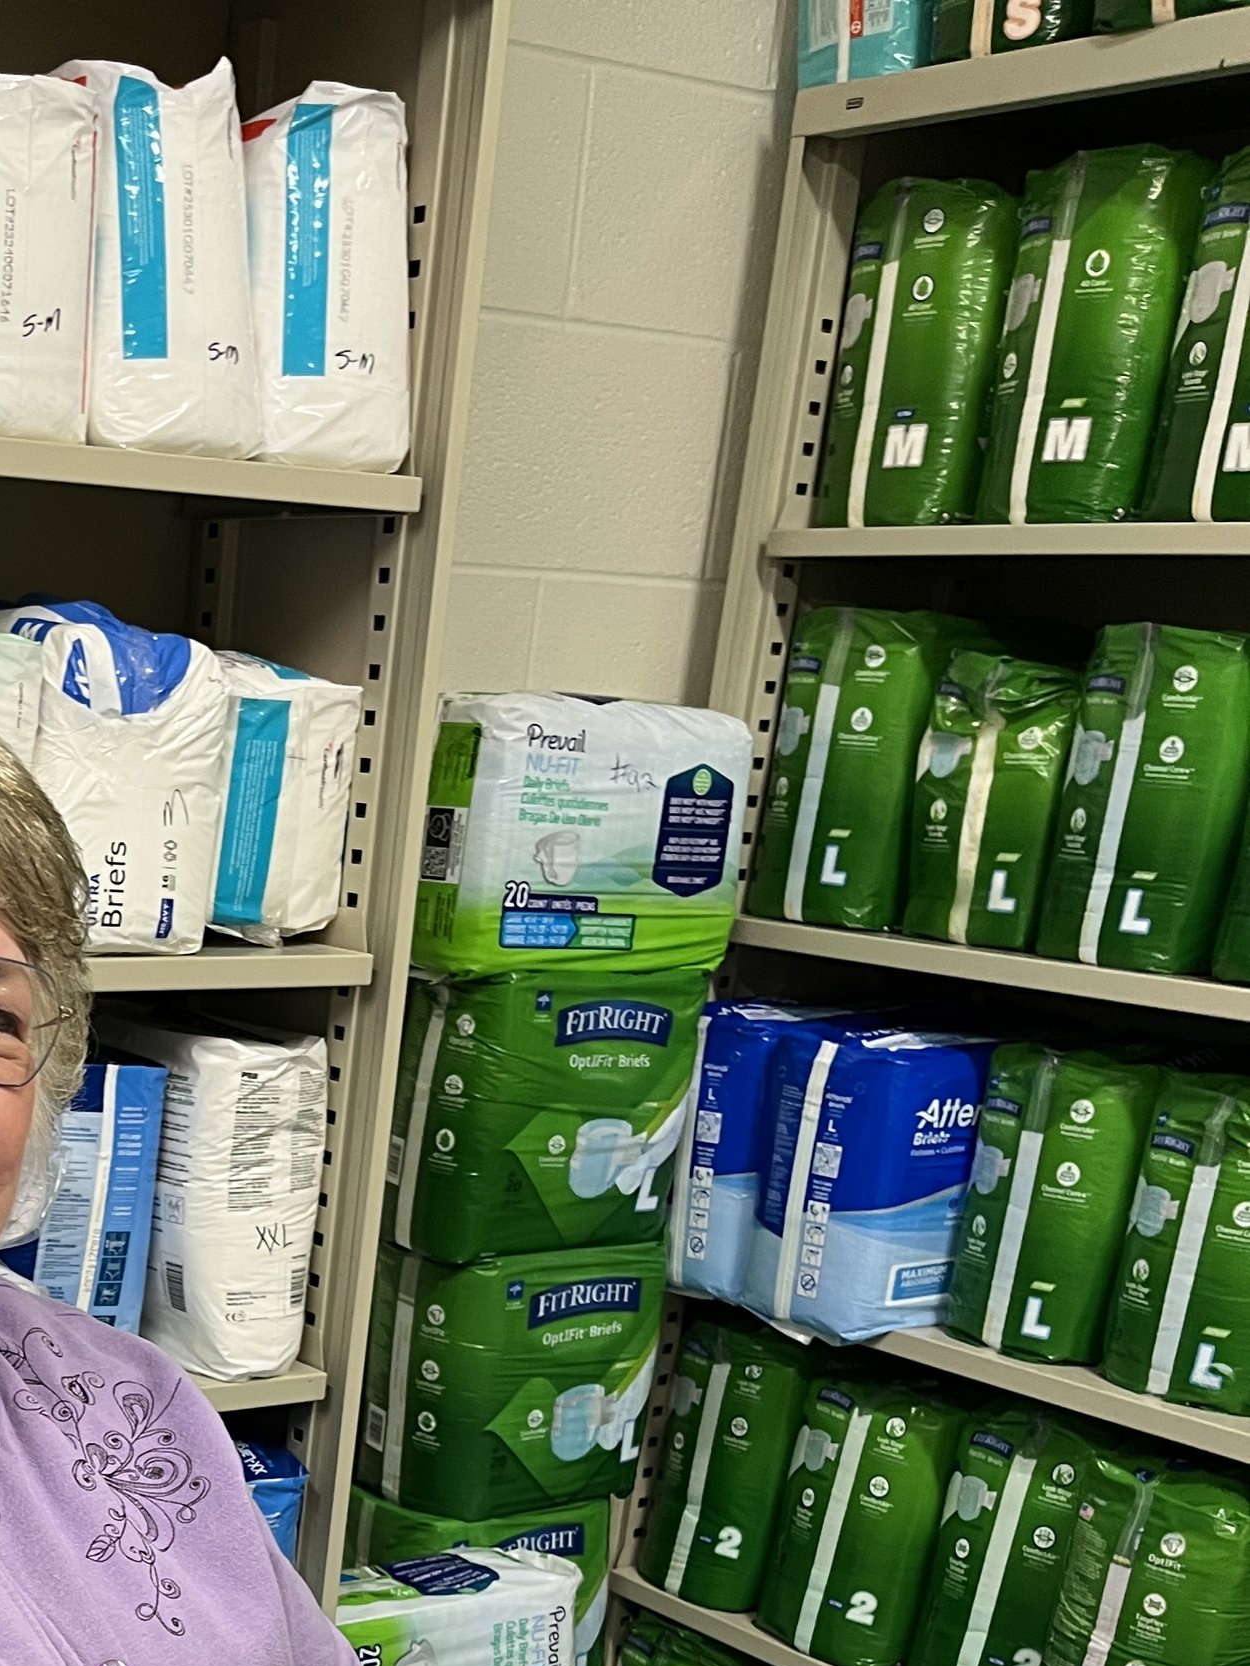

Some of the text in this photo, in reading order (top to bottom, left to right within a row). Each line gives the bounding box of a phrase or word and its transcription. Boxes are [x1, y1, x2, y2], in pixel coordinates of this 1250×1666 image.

[883, 423, 928, 468] M
[1042, 417, 1091, 462] M
[527, 723, 586, 753] Prevail
[526, 753, 581, 775] NU-FIT
[820, 844, 847, 886] L
[101, 841, 127, 928] Briefs
[504, 882, 529, 908] 20
[988, 870, 1016, 913] L
[1119, 888, 1150, 935] L
[618, 1054, 650, 1069] Briefs
[256, 1222, 293, 1255] XXL
[589, 1322, 622, 1338] Briefs
[1021, 1296, 1051, 1340] L
[1189, 1342, 1223, 1390] L
[505, 1525, 575, 1554] RIGHT
[714, 1526, 743, 1560] 2
[846, 1591, 878, 1626] 2
